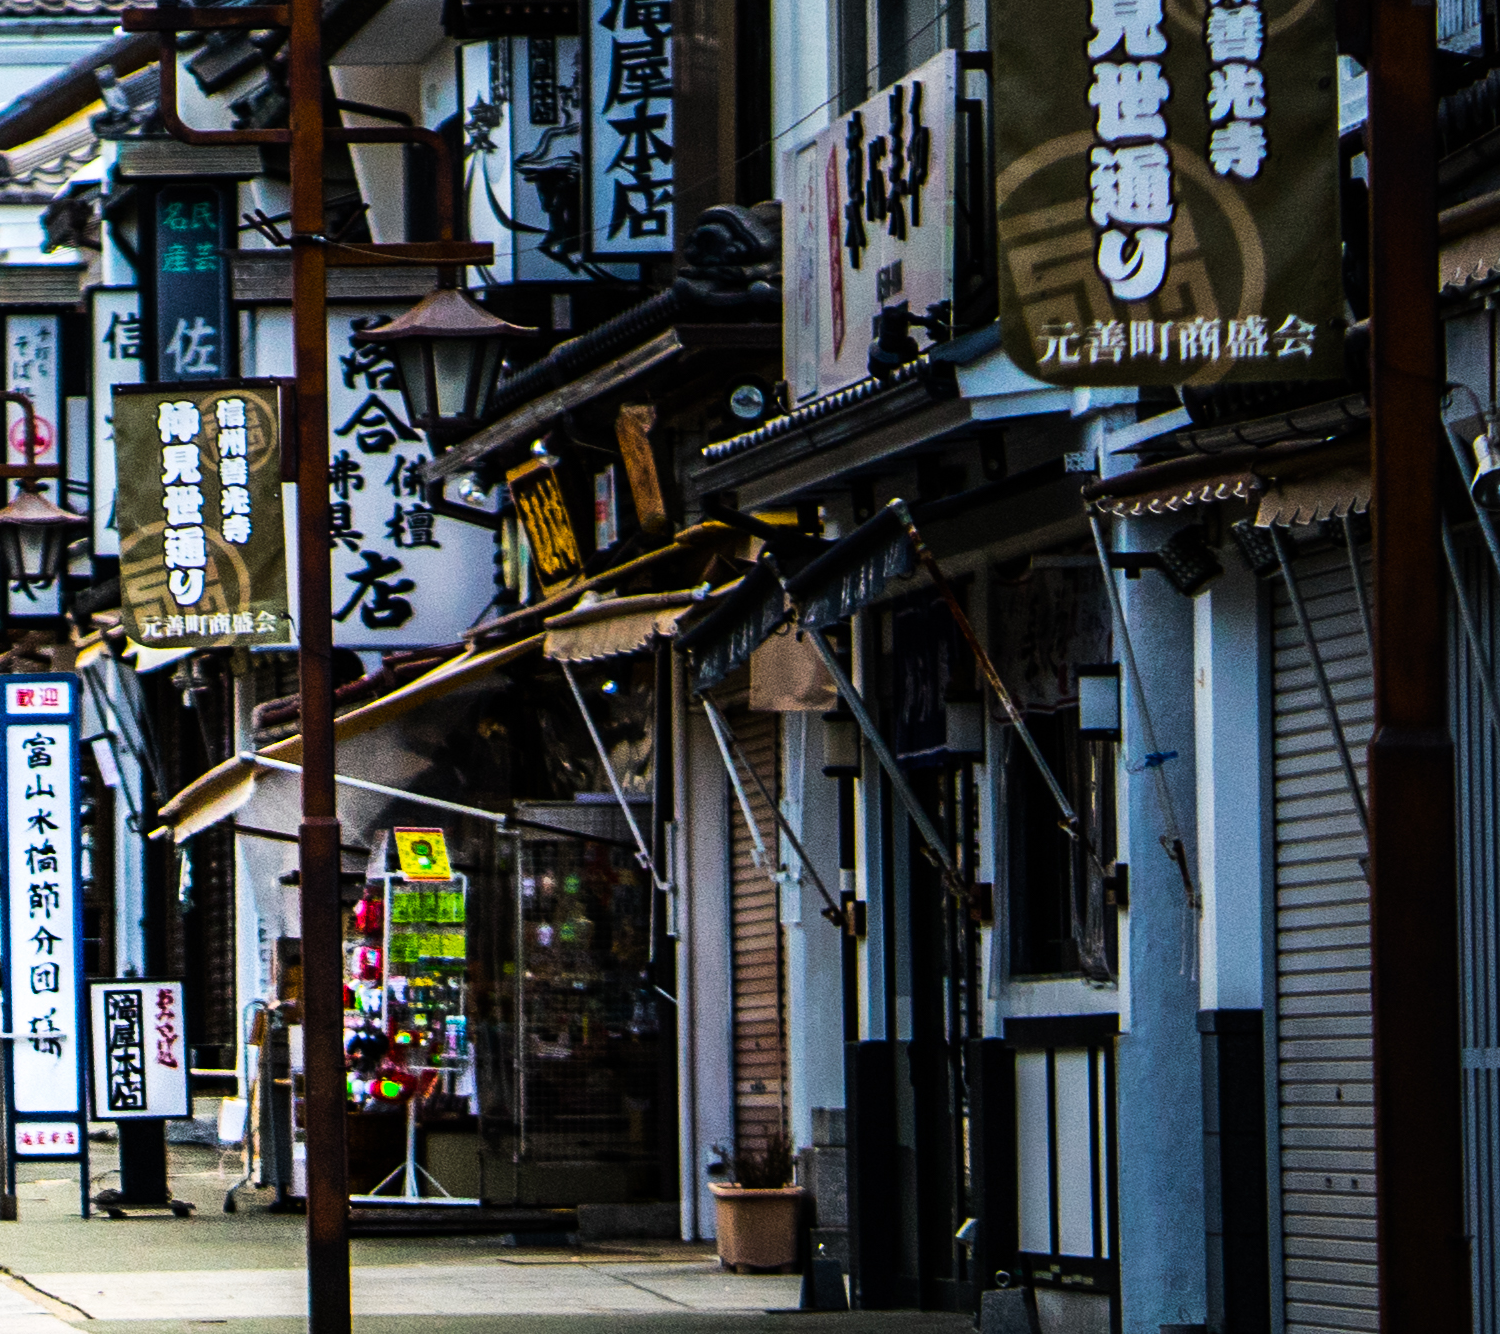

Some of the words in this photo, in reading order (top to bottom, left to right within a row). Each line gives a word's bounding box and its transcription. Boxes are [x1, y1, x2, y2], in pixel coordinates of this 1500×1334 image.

[1037, 315, 1318, 365] 元善町商盛会
[157, 401, 208, 606] 仲見世通り
[216, 399, 253, 545] 信州善光寺
[140, 609, 277, 639] 元善町商盛会
